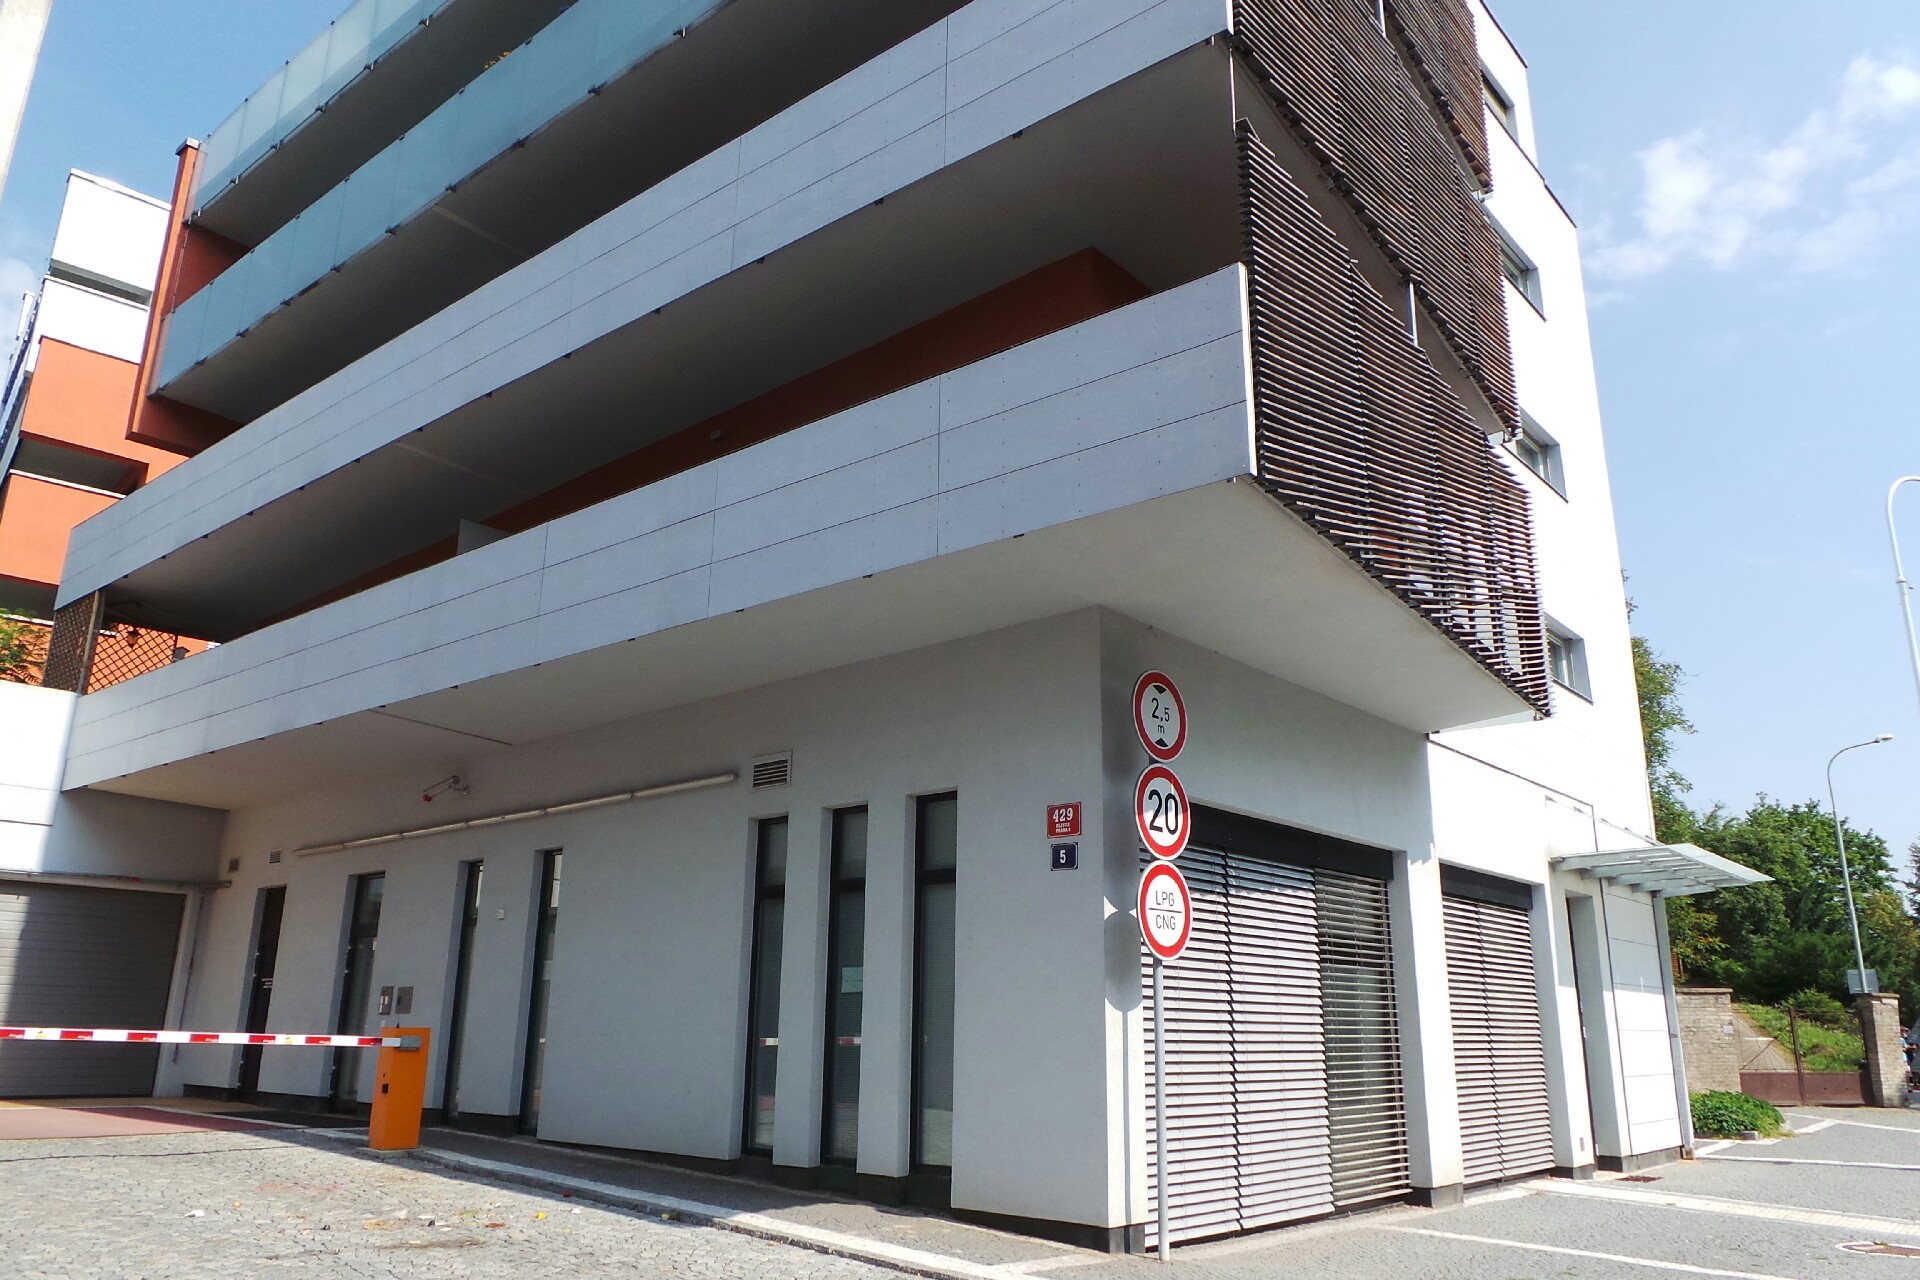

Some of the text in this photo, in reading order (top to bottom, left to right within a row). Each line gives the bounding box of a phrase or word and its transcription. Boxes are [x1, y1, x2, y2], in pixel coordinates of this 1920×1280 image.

[1151, 697, 1170, 722] 2,5
[1157, 724, 1165, 734] m
[1053, 808, 1073, 822] 429
[1148, 788, 1179, 836] 20
[1059, 849, 1066, 864] 5
[1155, 889, 1175, 907] LPG
[1155, 914, 1176, 931] CNG
